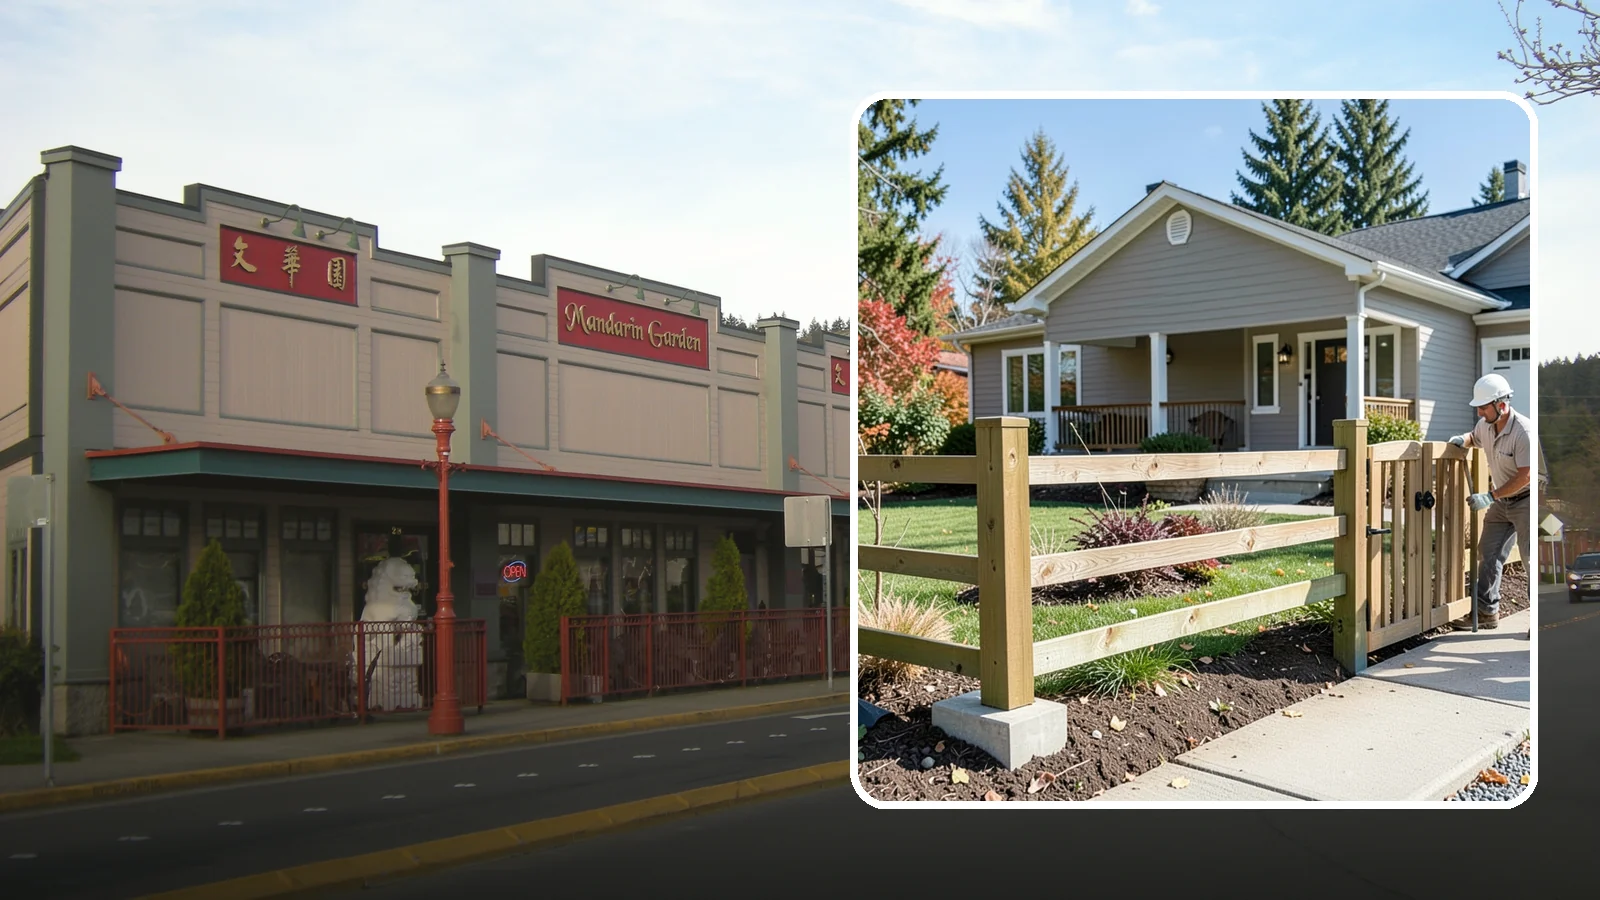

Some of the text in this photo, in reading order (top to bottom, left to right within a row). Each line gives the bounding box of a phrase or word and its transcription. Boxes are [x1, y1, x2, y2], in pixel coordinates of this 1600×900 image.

[231, 235, 347, 291] 文華園
[564, 302, 701, 352] Mandarin Garden
[503, 565, 527, 578] OPEN
